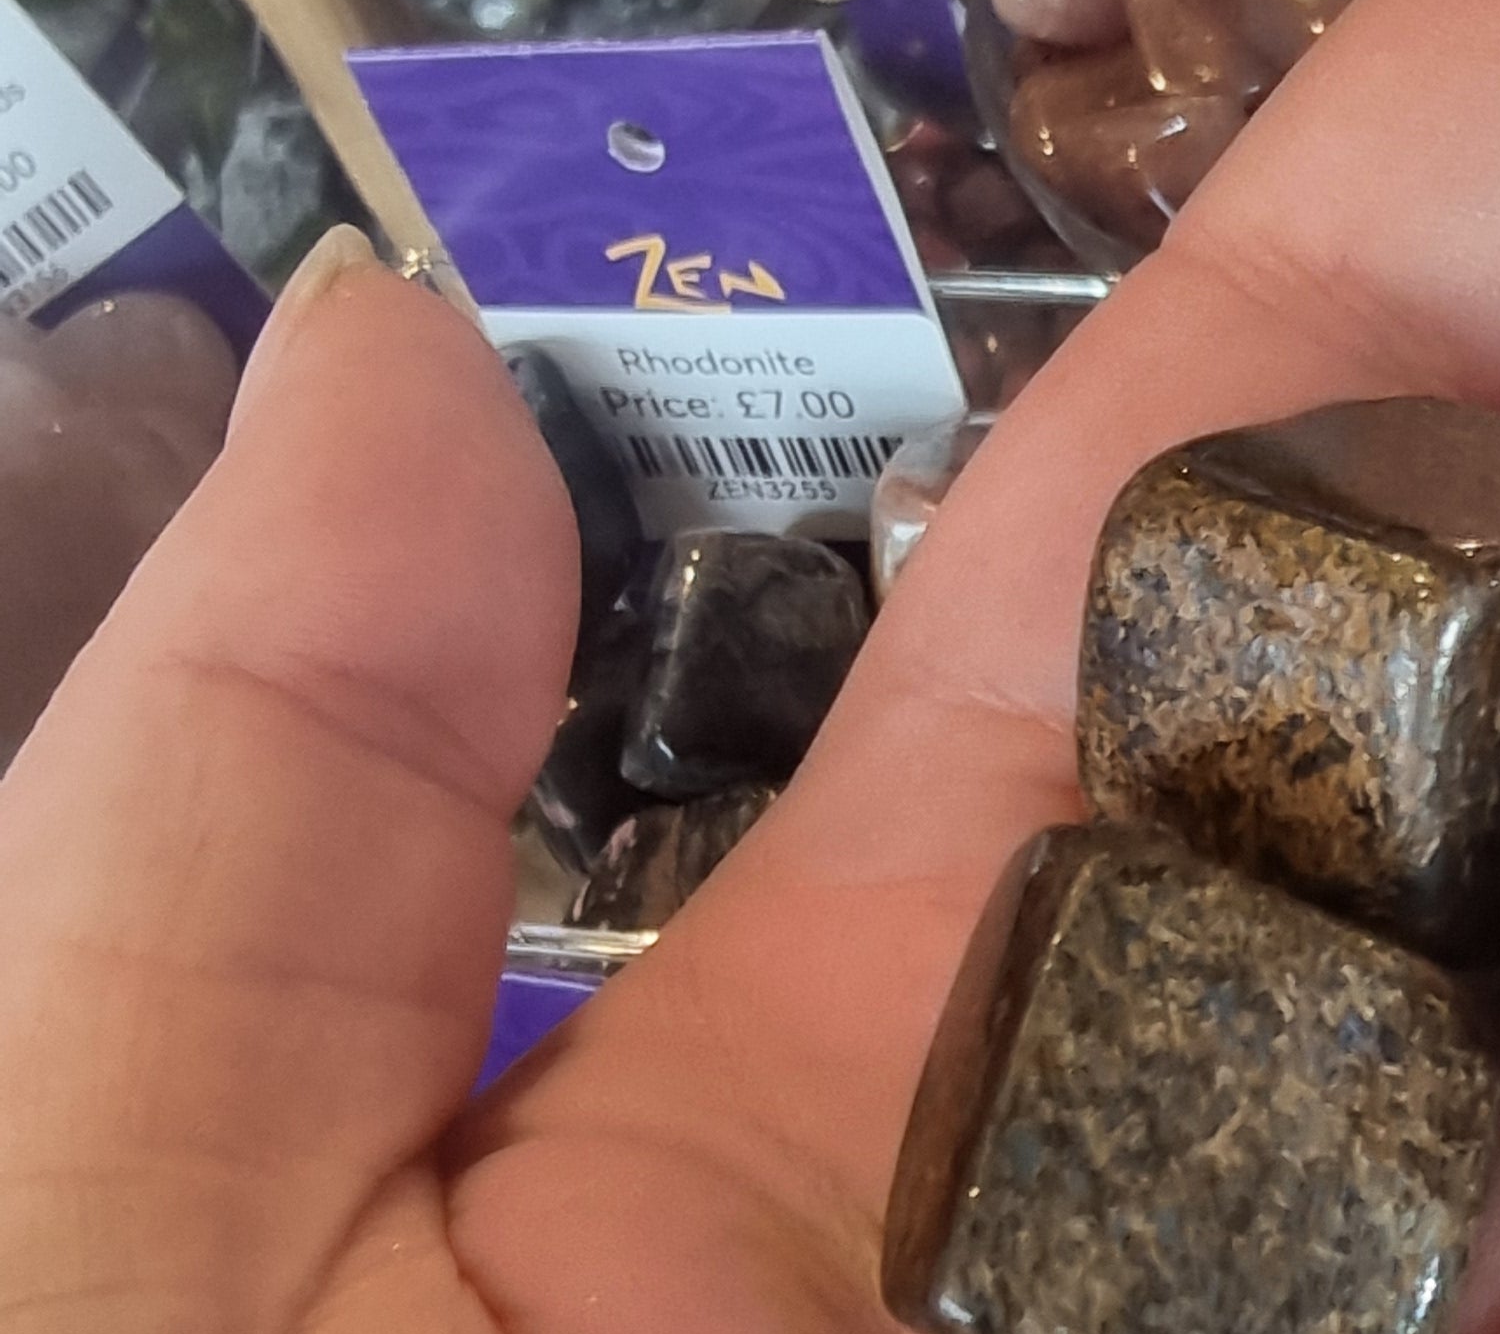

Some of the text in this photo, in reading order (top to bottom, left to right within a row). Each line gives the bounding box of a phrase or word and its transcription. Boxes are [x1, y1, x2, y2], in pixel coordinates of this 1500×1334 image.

[605, 234, 785, 314] ZEN
[618, 348, 815, 376] Rhodonite
[601, 387, 855, 420] Price: £7.00
[707, 479, 837, 502] ZEN3255
